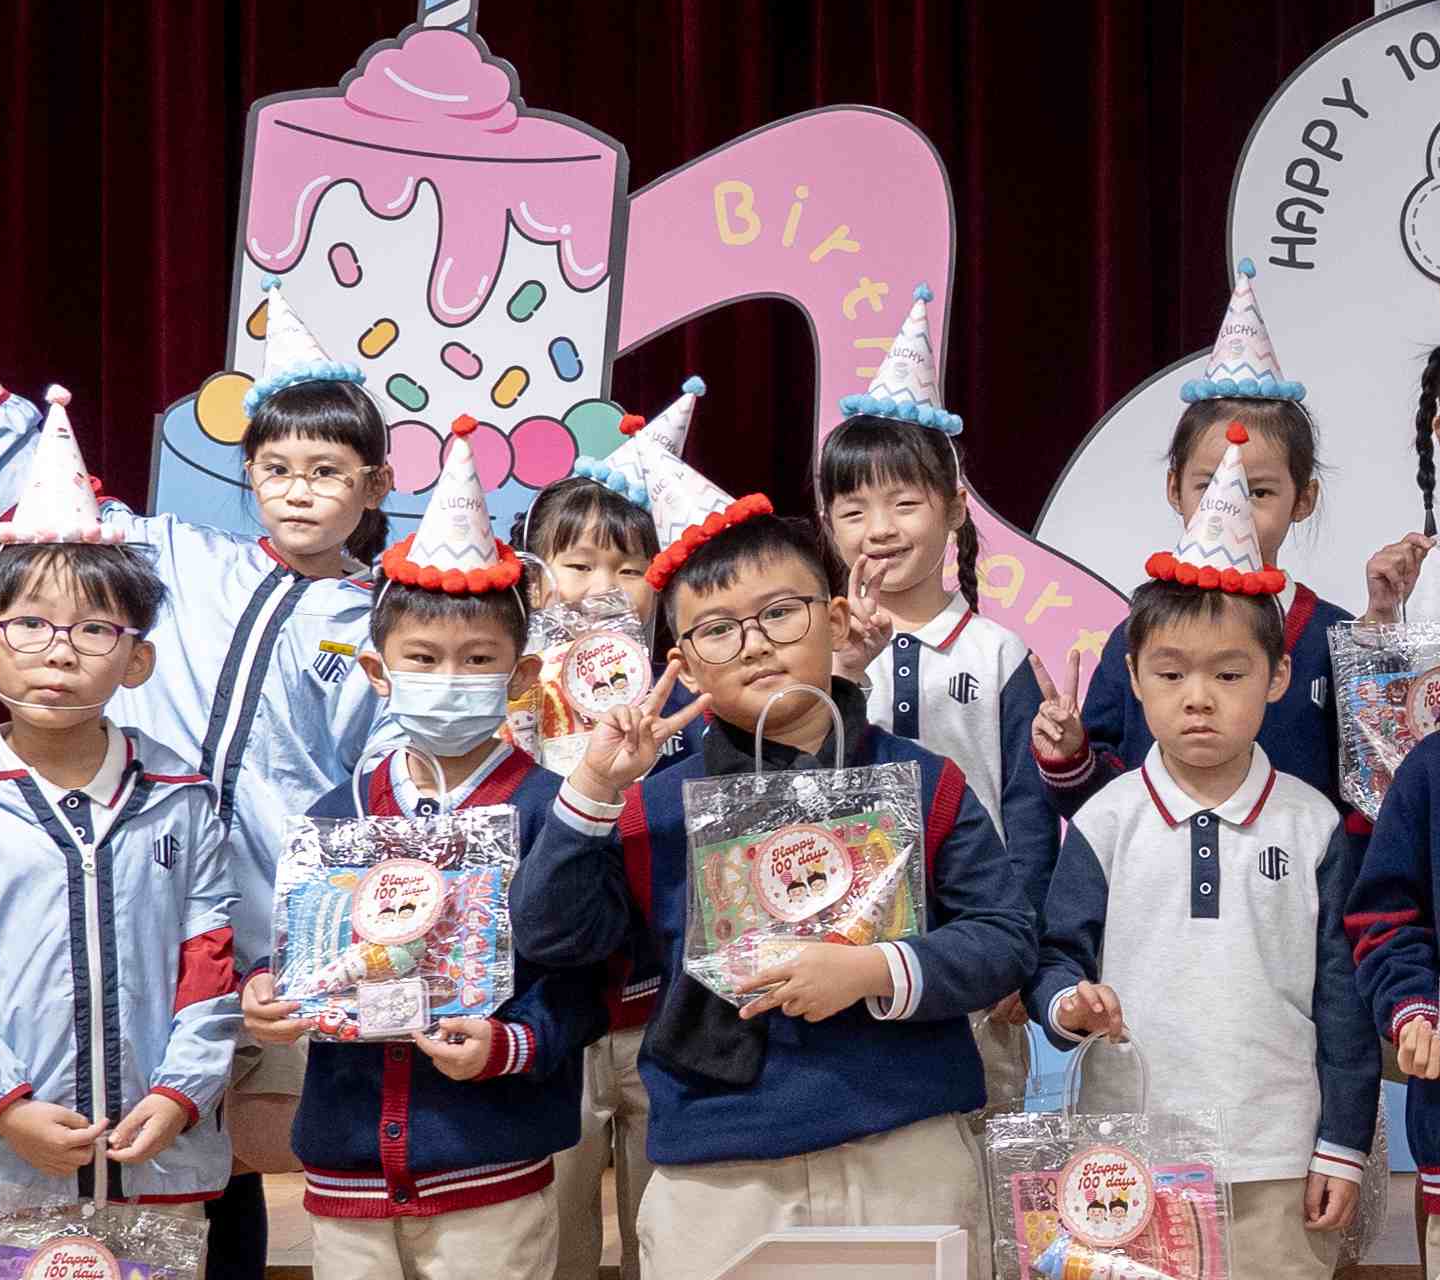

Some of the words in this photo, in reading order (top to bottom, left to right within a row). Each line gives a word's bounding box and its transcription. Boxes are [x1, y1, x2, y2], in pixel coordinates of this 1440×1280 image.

[1267, 77, 1370, 271] HAPPY
[575, 662, 595, 678] 100
[599, 648, 628, 667] days
[576, 642, 614, 665] Happy
[772, 835, 817, 862] Happy
[770, 859, 792, 878] 100
[797, 845, 829, 867] days
[1083, 1161, 1129, 1177] Happy
[1078, 1176, 1100, 1190] 100
[1105, 1176, 1137, 1191] days
[51, 1251, 99, 1268] Happy
[43, 1266, 69, 1279] 100
